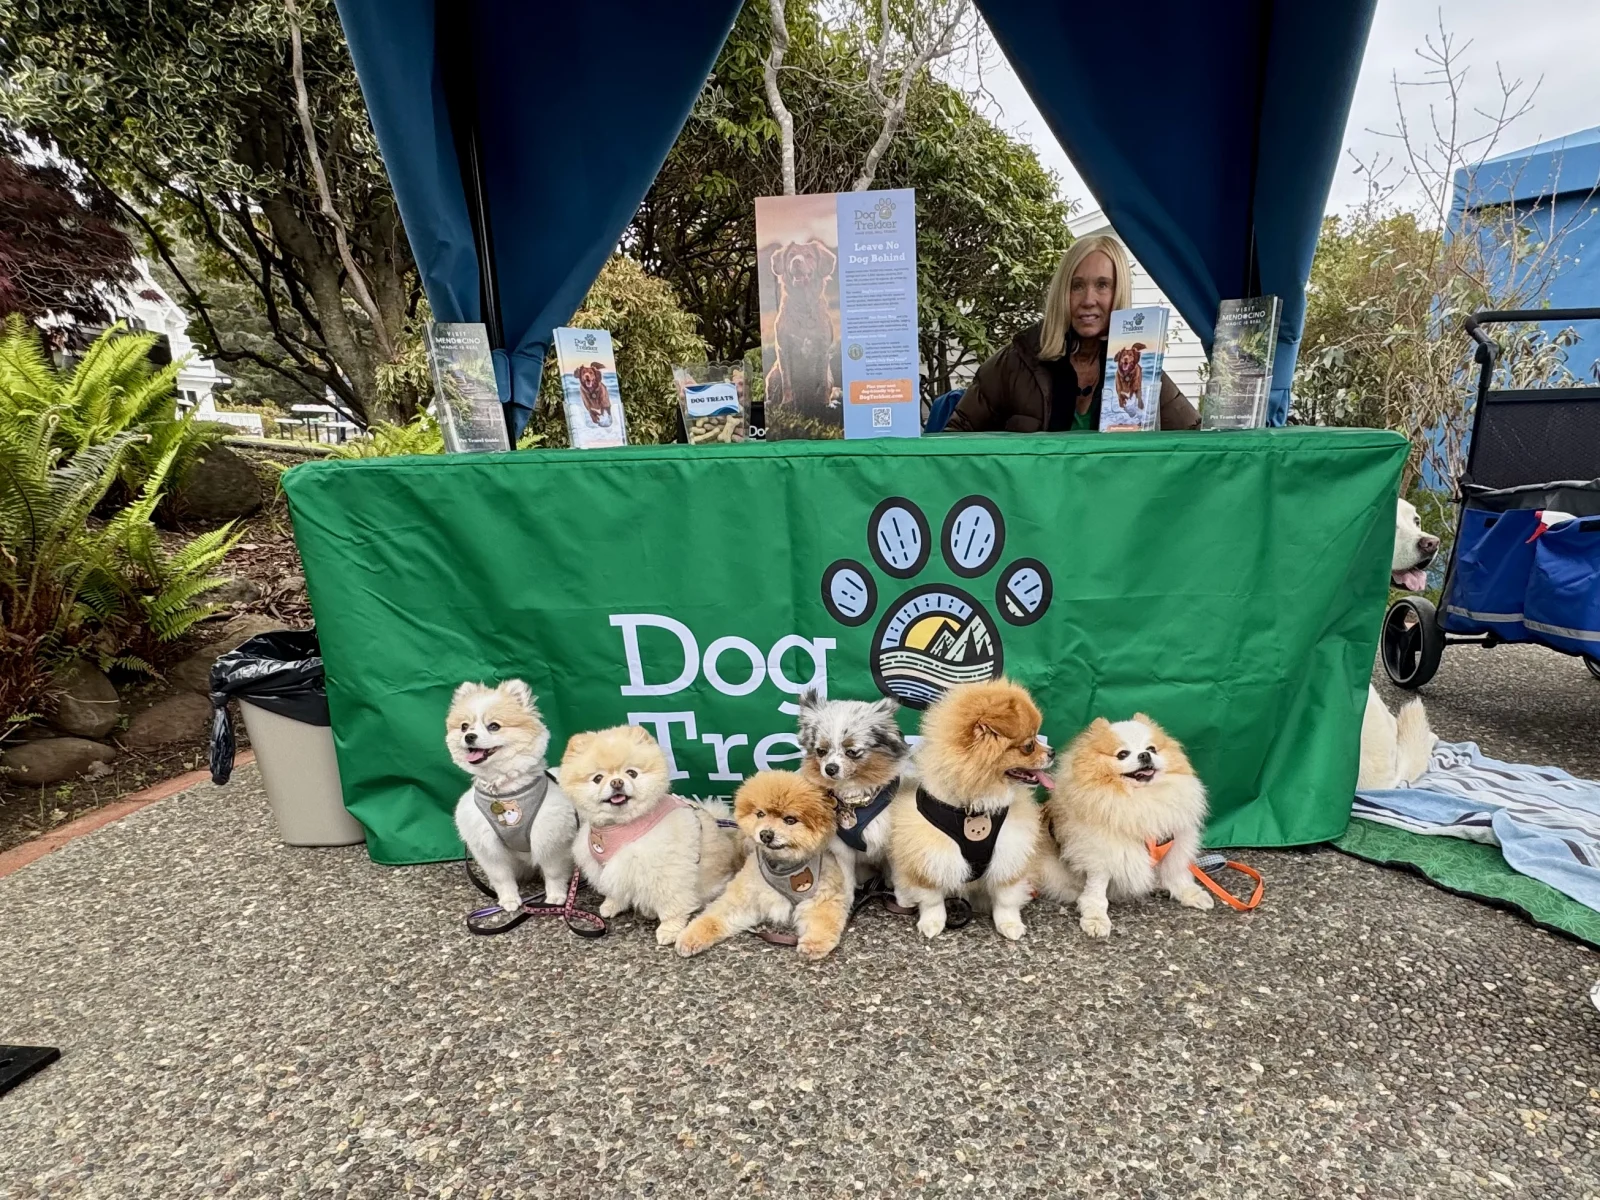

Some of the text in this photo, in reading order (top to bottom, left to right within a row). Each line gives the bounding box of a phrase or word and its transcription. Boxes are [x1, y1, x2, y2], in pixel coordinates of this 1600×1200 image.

[854, 209, 876, 222] Dog
[854, 219, 897, 230] Trekker
[854, 241, 900, 252] Leave No
[848, 252, 906, 265] Dog Behind
[1235, 305, 1255, 313] VISIT
[1222, 310, 1266, 321] MENDOCINO
[1123, 320, 1134, 328] Dog
[435, 336, 481, 344] MENDOCINO
[707, 395, 734, 403] TREATS
[609, 613, 837, 715] Dog
